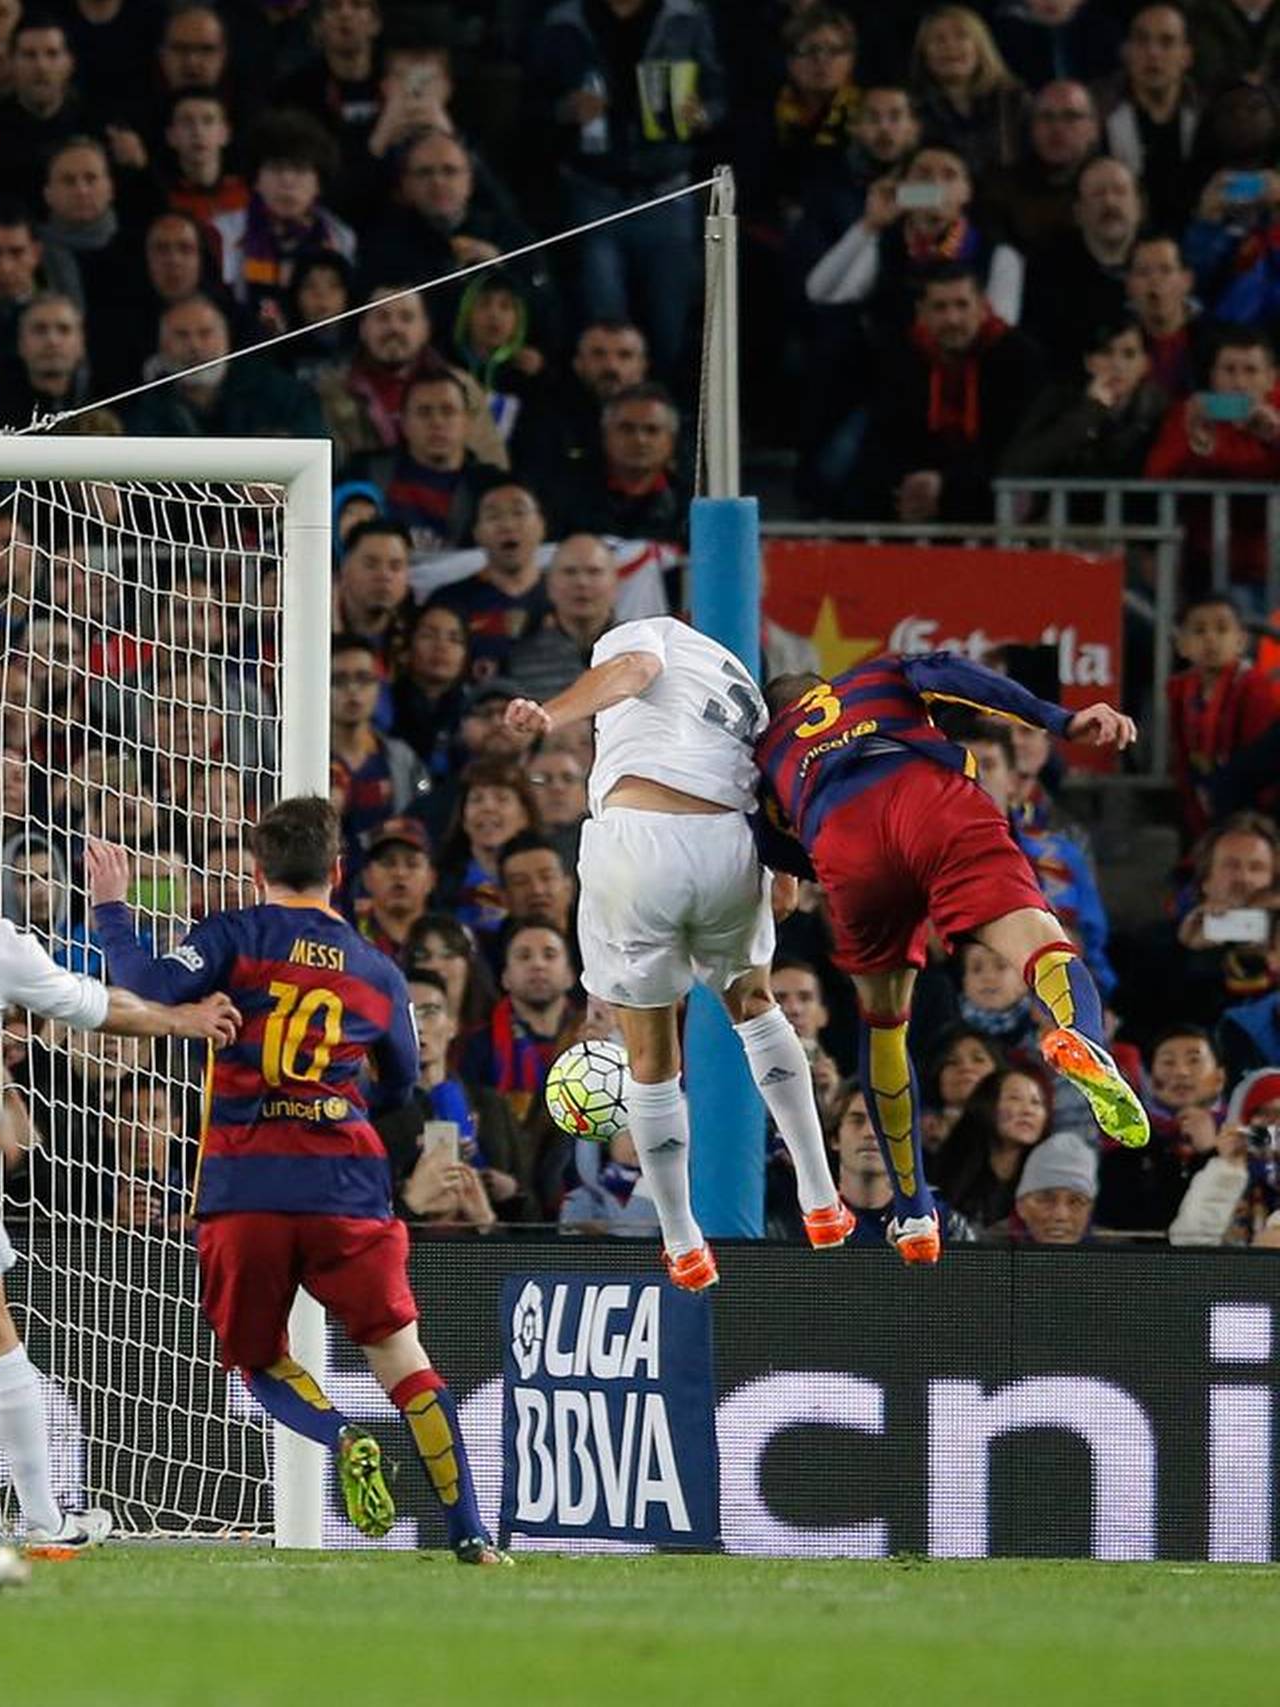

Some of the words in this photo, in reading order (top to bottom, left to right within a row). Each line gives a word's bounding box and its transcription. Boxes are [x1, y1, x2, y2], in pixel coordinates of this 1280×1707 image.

[793, 684, 841, 738] 3
[289, 938, 345, 971] MESSI
[262, 981, 343, 1087] 10
[262, 1099, 322, 1121] unicef
[544, 1284, 661, 1380] LIGA
[513, 1386, 693, 1532] BBVA
